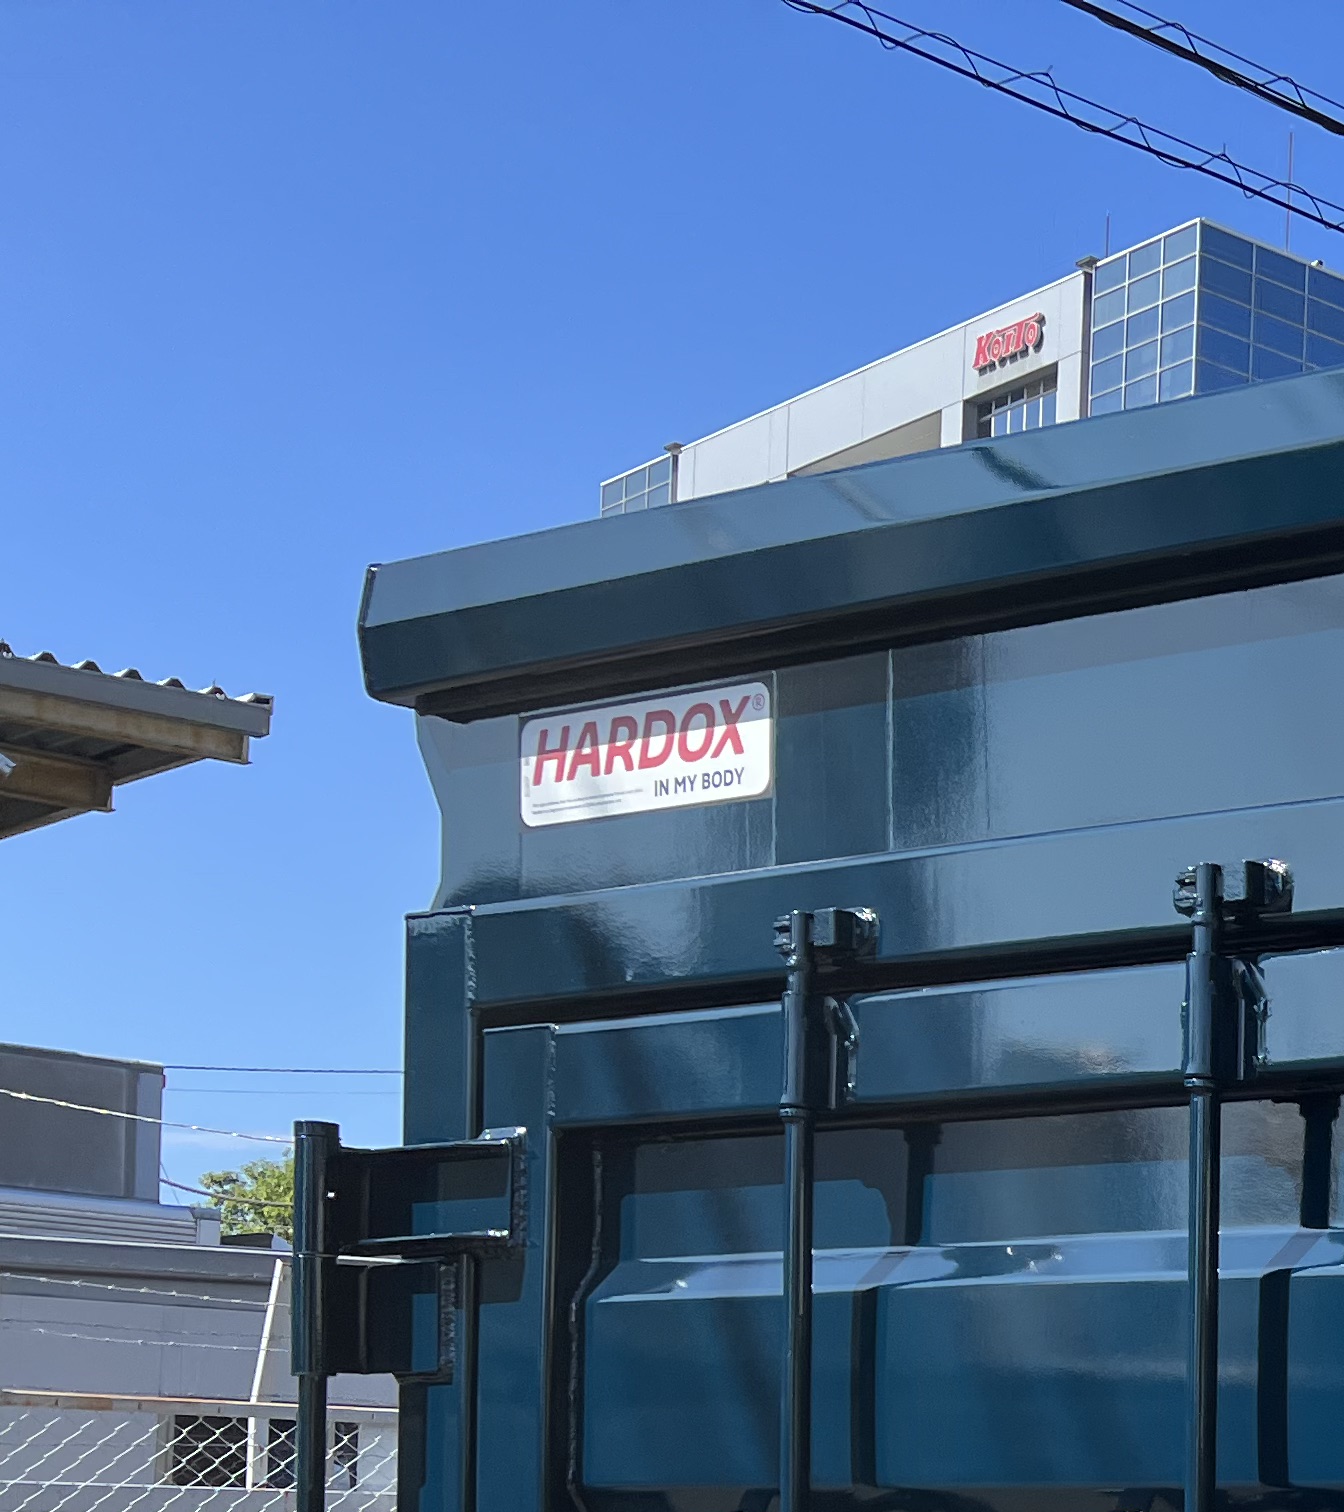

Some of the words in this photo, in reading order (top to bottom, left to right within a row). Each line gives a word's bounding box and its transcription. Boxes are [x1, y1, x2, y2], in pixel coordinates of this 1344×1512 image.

[654, 780, 669, 797] IN
[674, 774, 697, 793] MY
[702, 767, 745, 790] BODY
